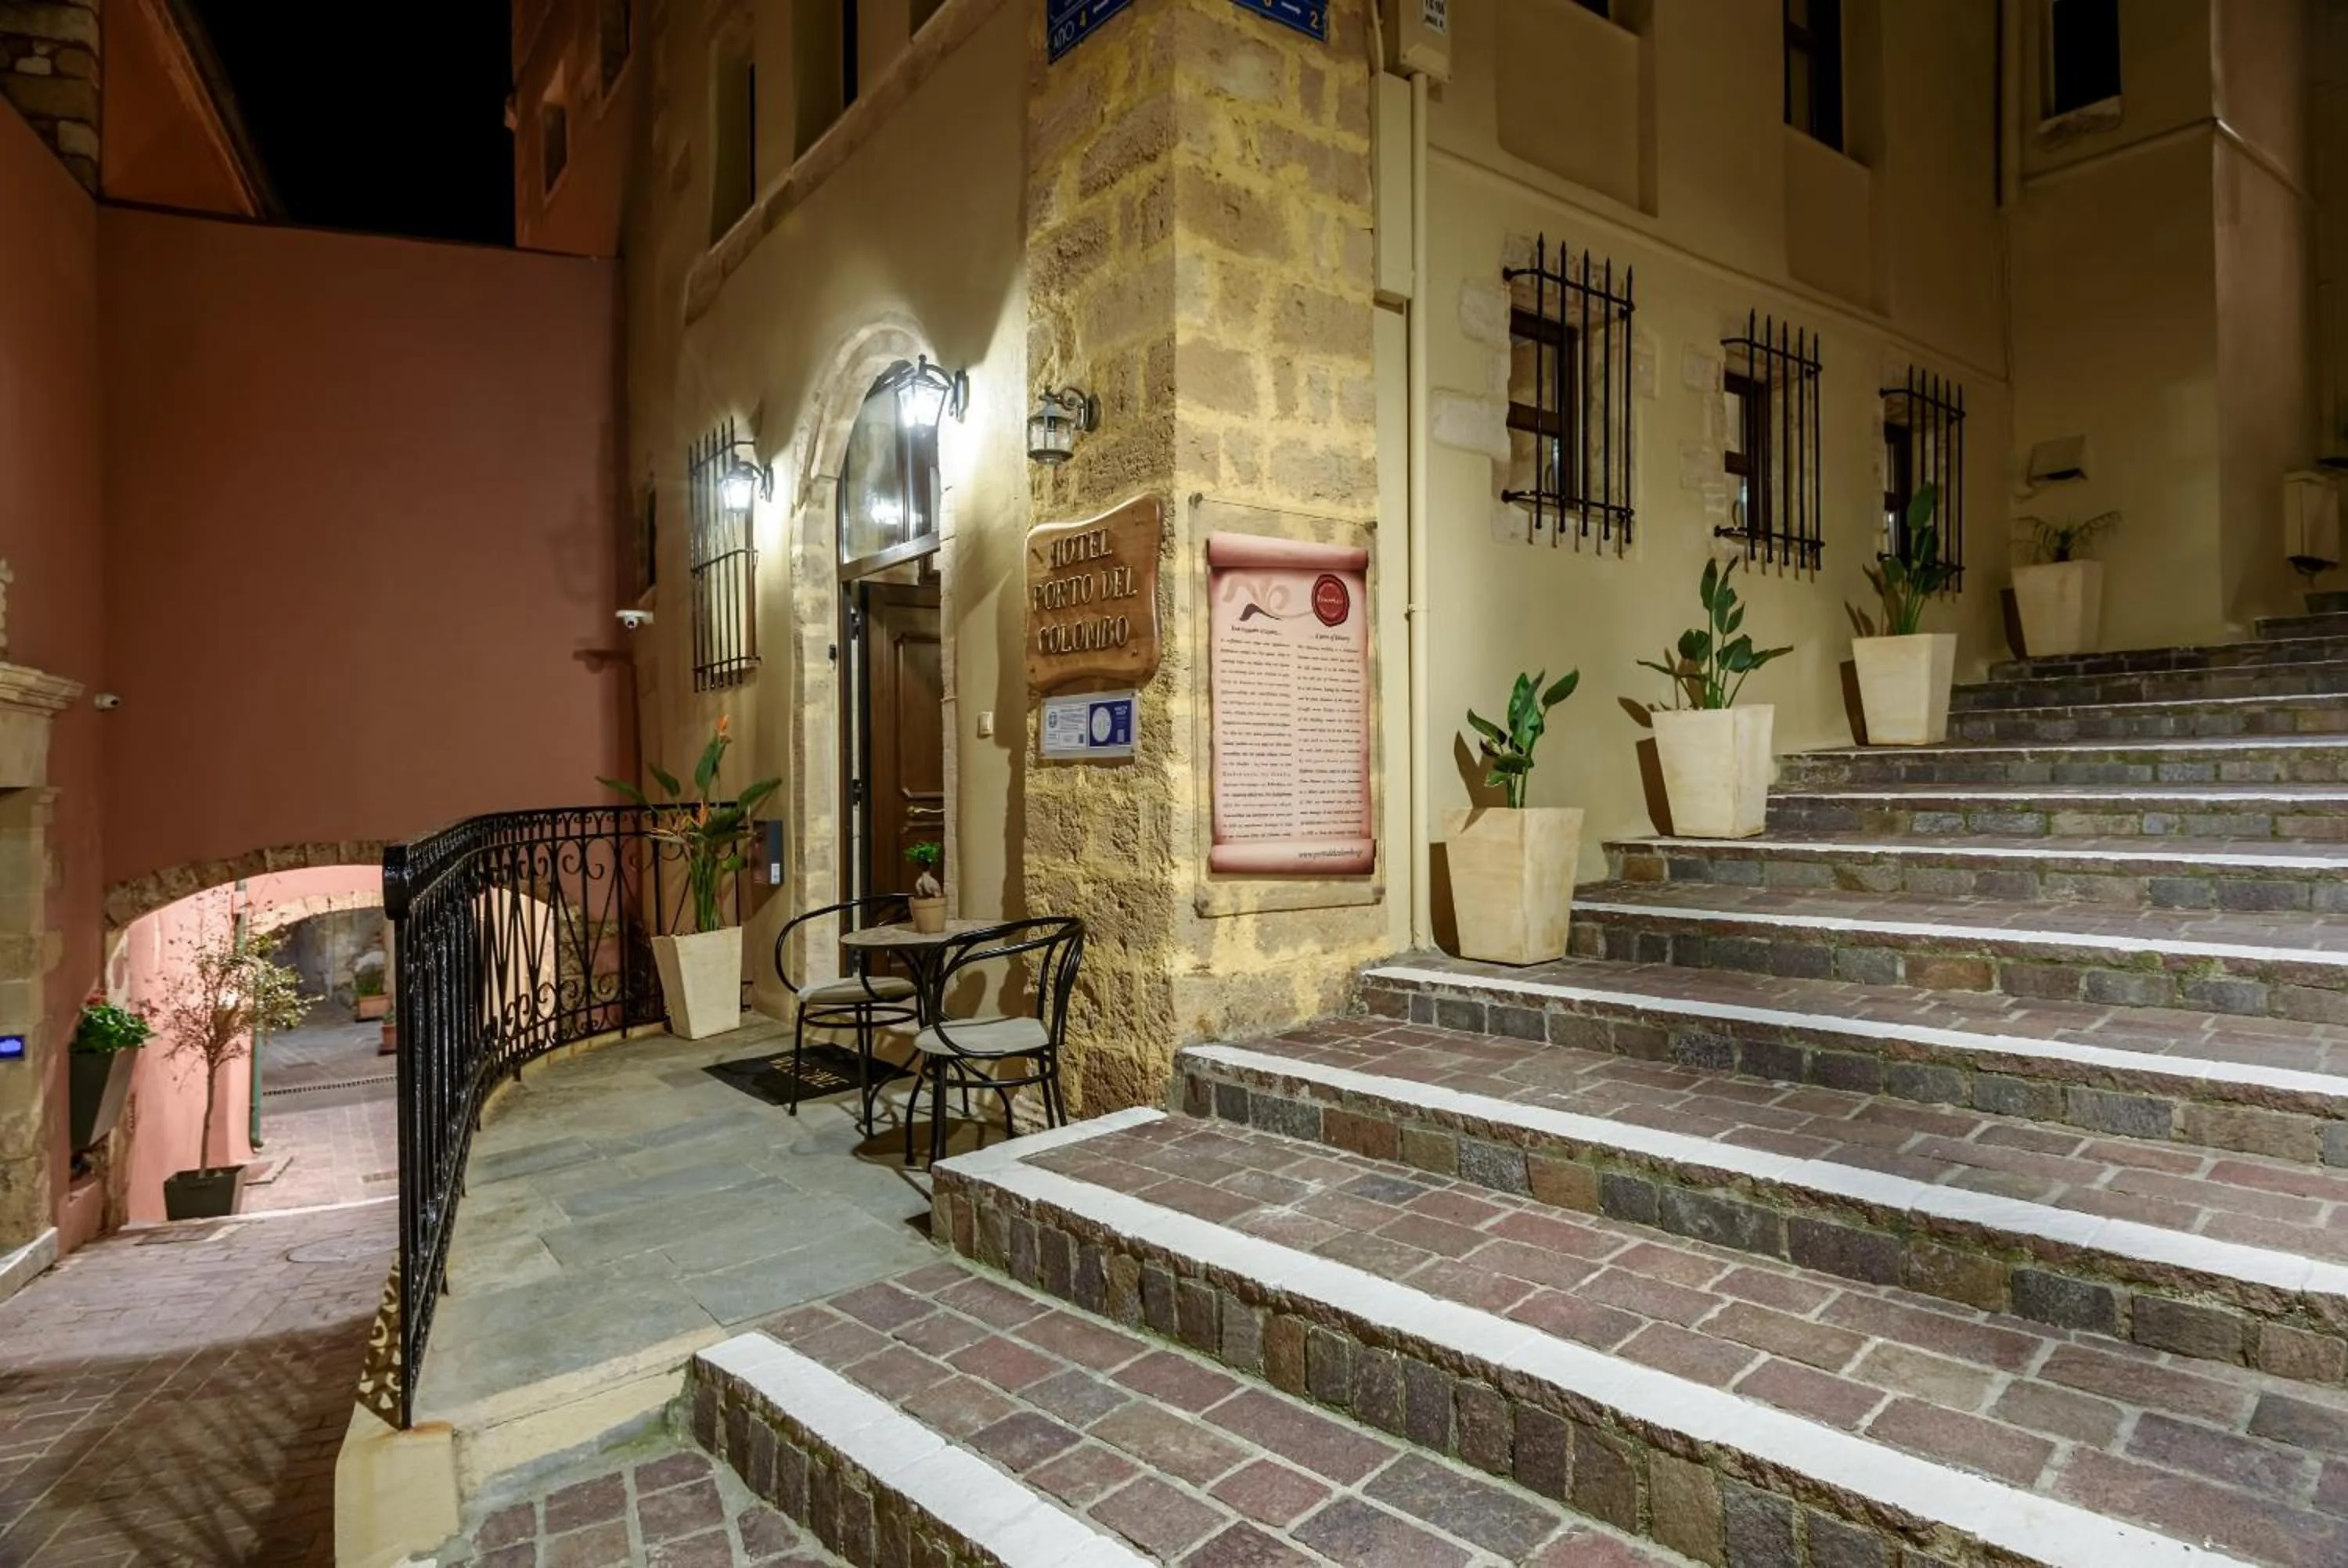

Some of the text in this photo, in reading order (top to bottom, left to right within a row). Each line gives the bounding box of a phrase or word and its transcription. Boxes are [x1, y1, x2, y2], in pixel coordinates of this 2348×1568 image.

[1309, 10, 1319, 29] 2
[1048, 527, 1112, 570] HOTEL
[1033, 565, 1138, 613] PORTO DEL
[1039, 614, 1129, 654] COLOMBO
